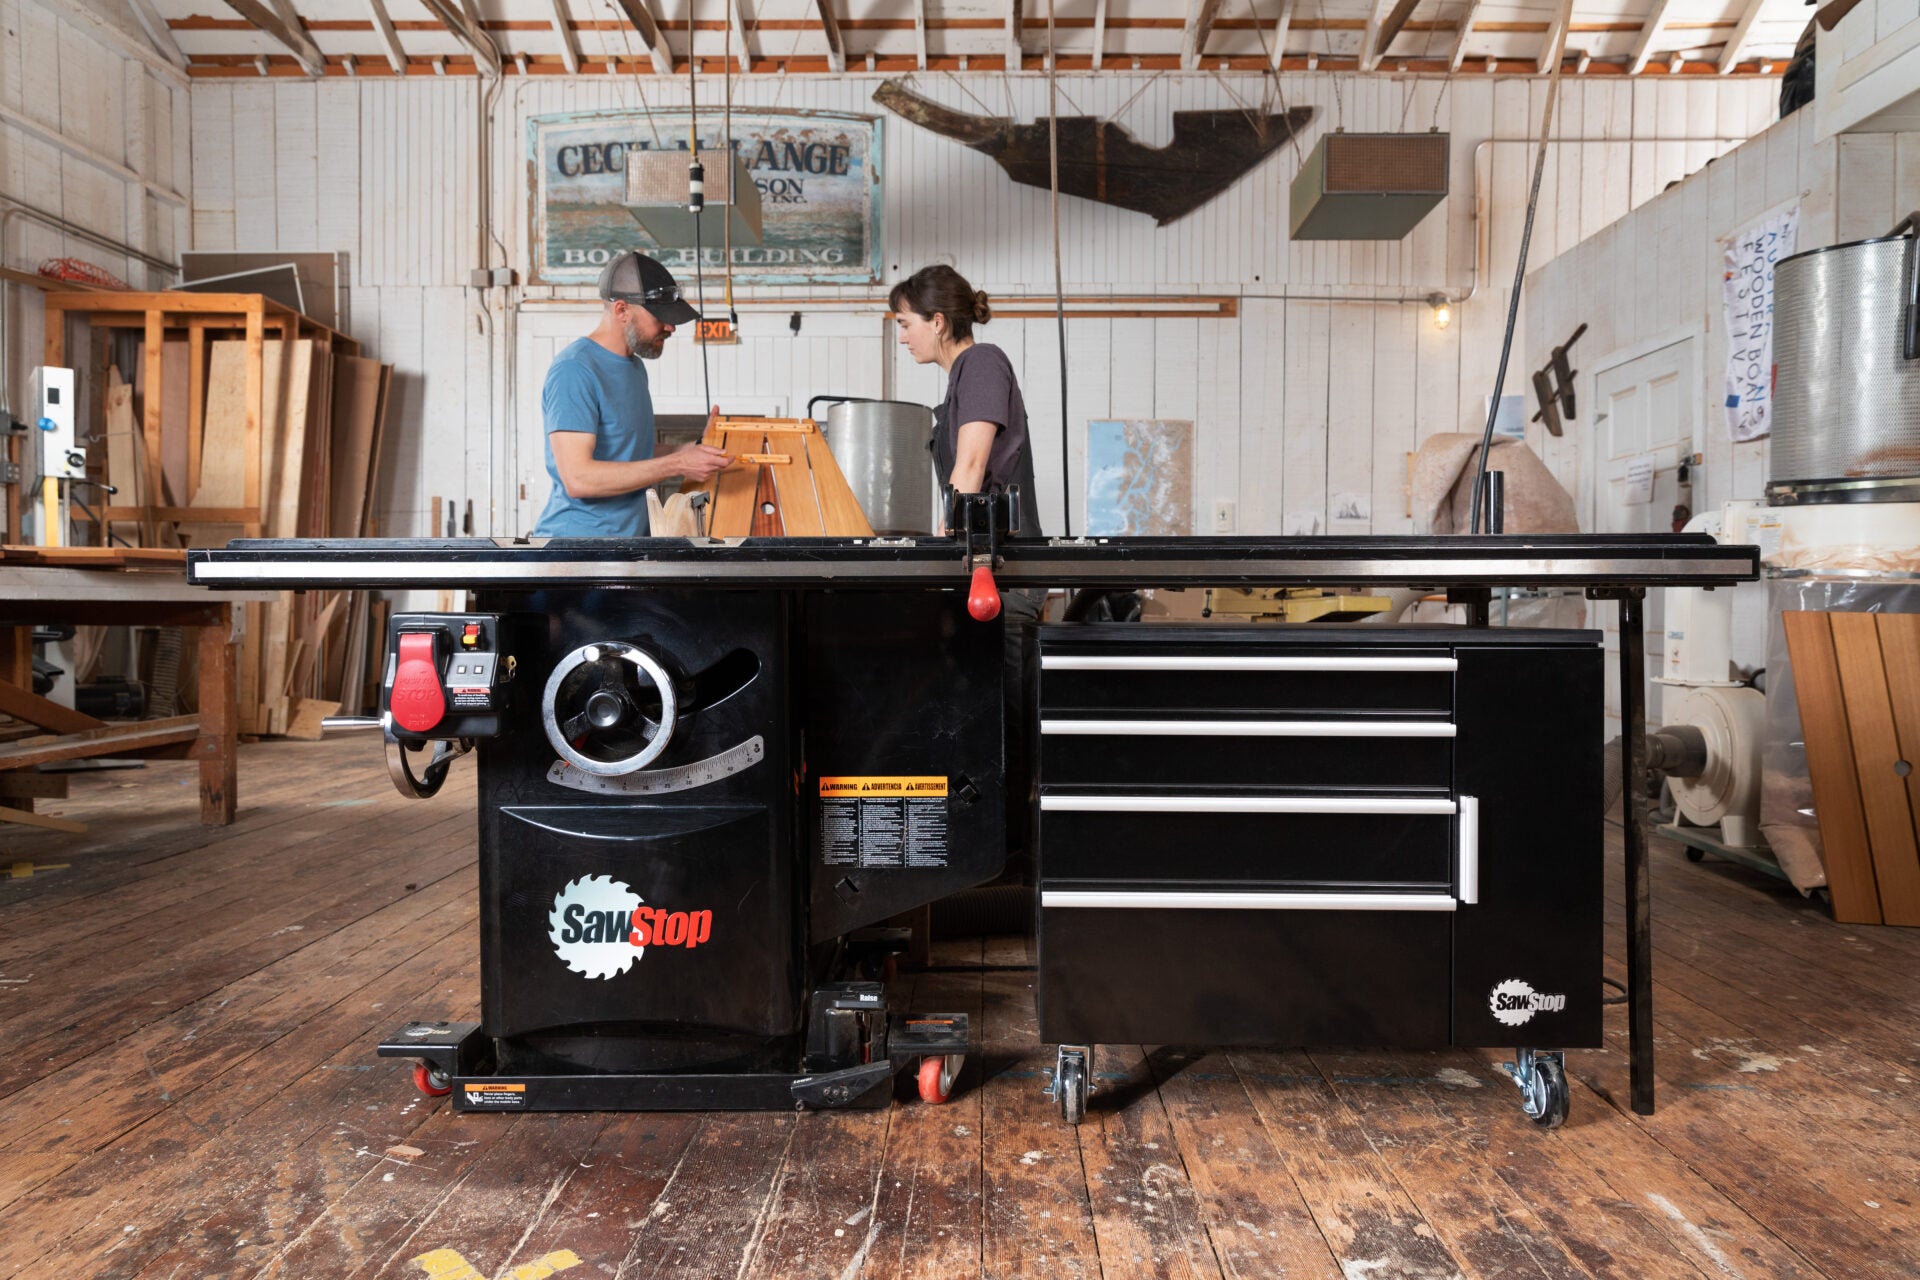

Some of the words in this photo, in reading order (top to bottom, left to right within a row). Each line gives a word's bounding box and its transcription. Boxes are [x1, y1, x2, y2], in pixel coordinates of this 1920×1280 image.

[557, 141, 651, 177] CEC
[731, 140, 849, 176] ANGE
[754, 178, 804, 195] SON
[678, 247, 844, 264] BUILDING
[1750, 234, 1766, 340] WOODEN
[696, 321, 730, 338] EXIT
[829, 783, 858, 791] WARNING
[871, 783, 902, 791] ADVERTENCIA
[915, 783, 946, 791] AVERTISSEMENT
[561, 904, 713, 949] SawStop
[860, 994, 878, 1002] Raise
[1496, 992, 1566, 1012] SawStop
